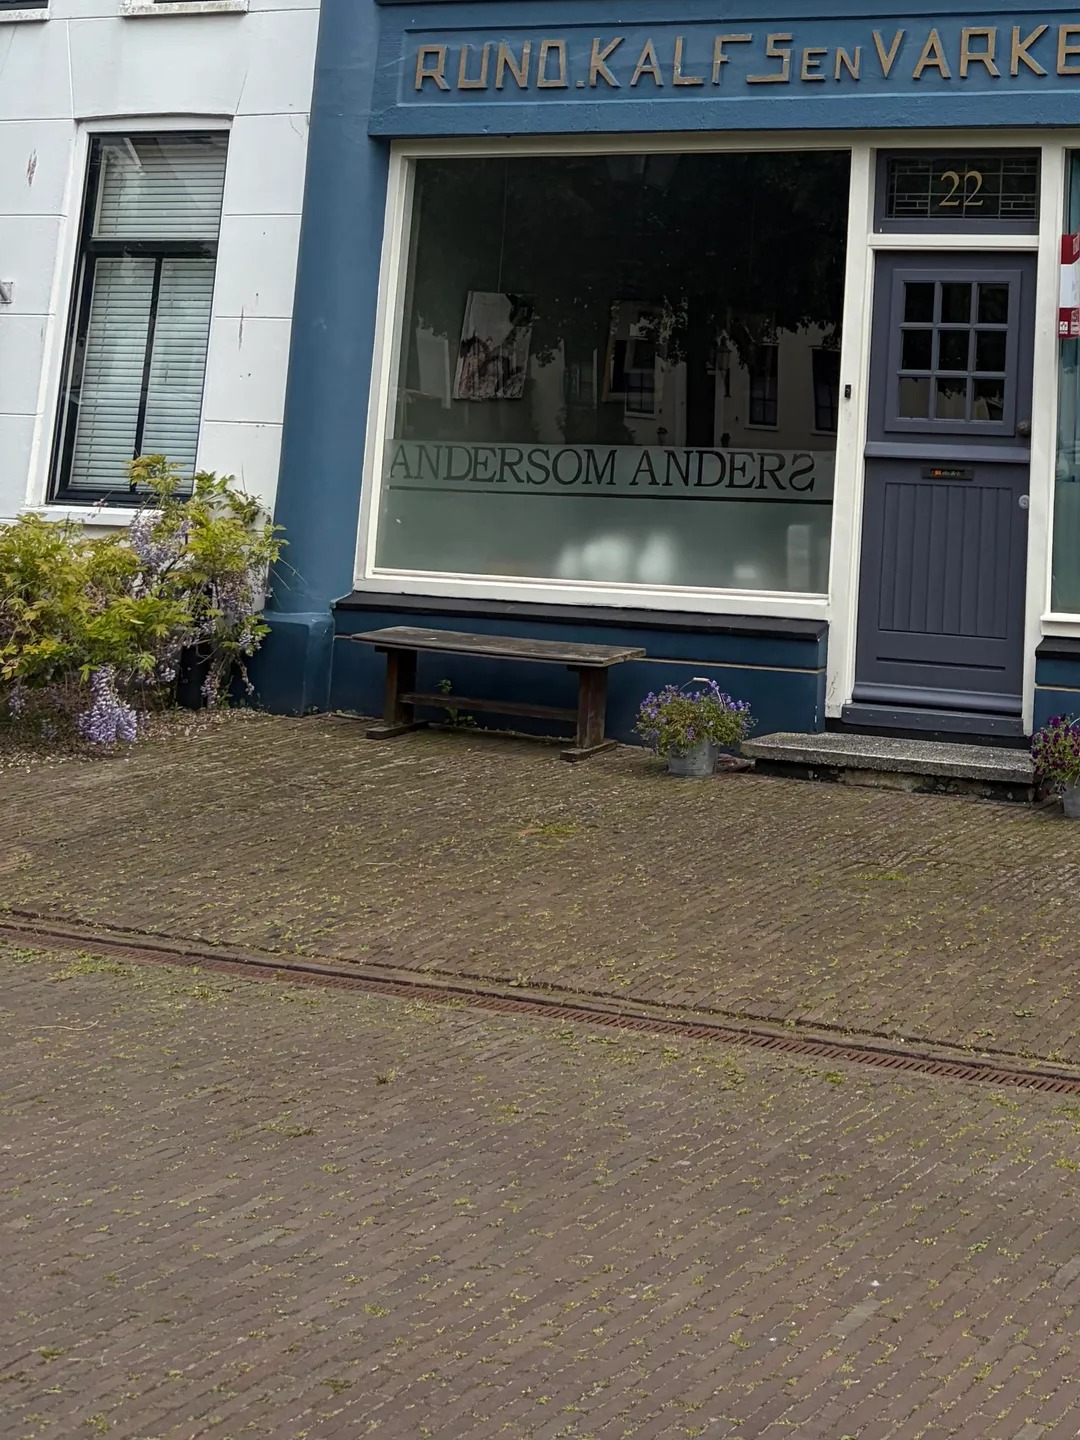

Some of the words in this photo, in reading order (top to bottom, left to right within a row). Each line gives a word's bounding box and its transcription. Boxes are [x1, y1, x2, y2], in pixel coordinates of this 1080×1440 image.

[939, 170, 984, 206] 22
[390, 444, 618, 485] ANDERSOM
[629, 449, 815, 491] ANDERS
